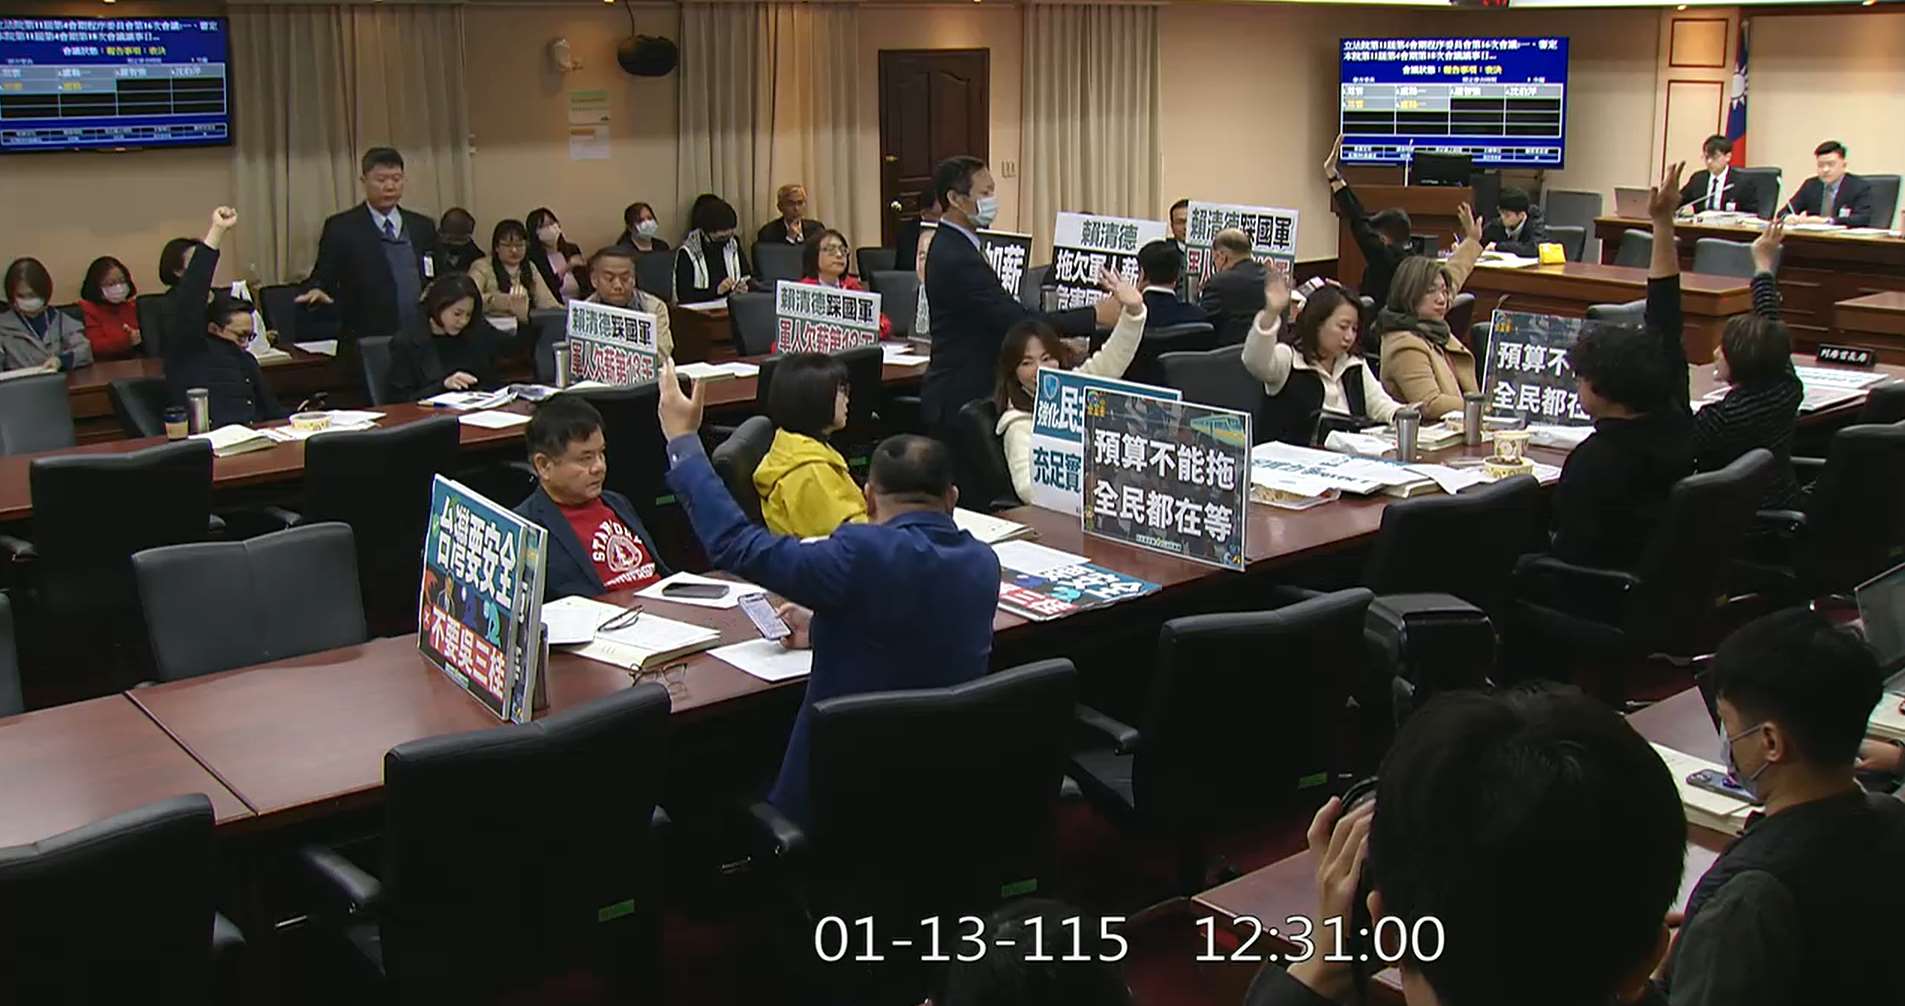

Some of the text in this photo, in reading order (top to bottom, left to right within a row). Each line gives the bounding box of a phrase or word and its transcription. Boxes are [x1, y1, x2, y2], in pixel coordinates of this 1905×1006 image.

[1081, 219, 1139, 250] 賴清德
[572, 307, 651, 345] 賴清德踩國軍
[781, 287, 874, 323] 賴清德踩國軍
[1497, 341, 1577, 378] 預算不
[1037, 386, 1084, 434] 強化民
[1034, 447, 1081, 492] 充足實
[1094, 429, 1235, 490] 預算不能拖
[1093, 479, 1233, 543] 全民都在等
[437, 495, 517, 609] 台灣要安全
[431, 605, 505, 700] 不要吳三桂
